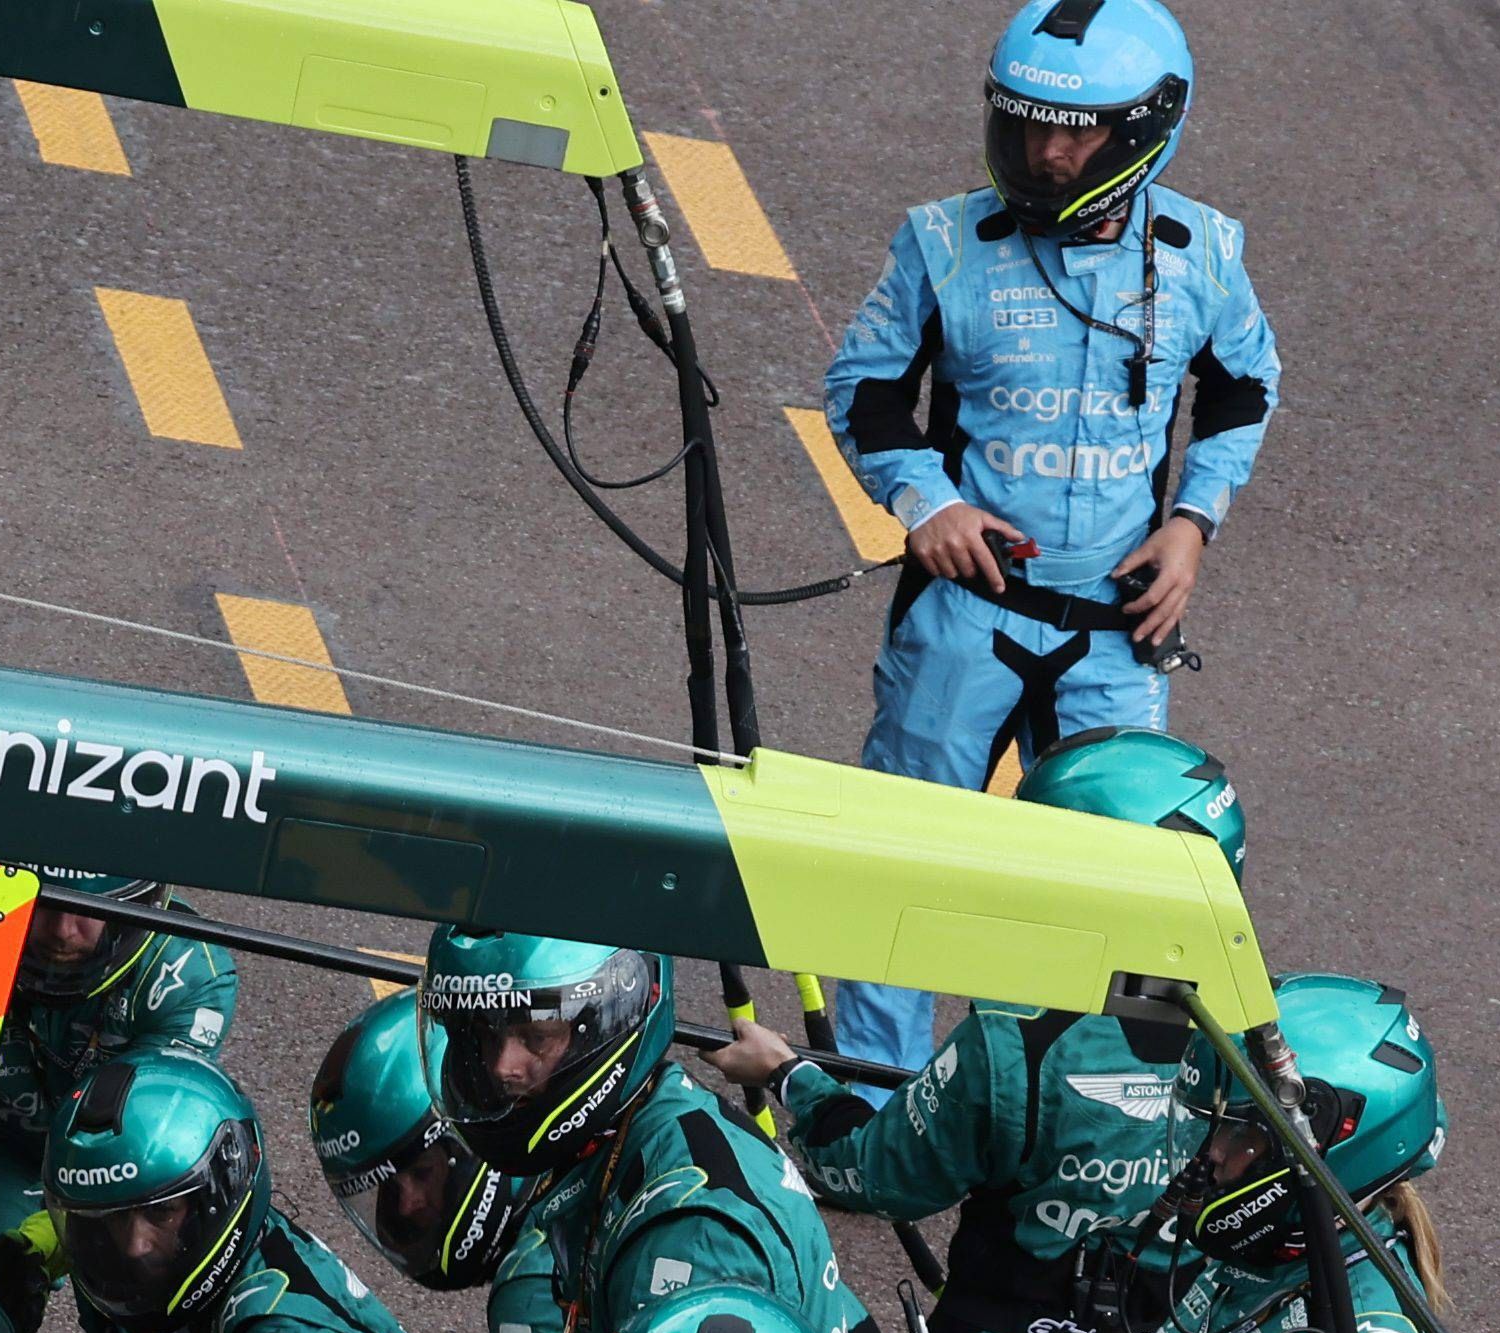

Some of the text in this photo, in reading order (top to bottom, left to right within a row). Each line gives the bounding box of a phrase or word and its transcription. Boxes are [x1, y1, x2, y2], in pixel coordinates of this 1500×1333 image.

[1008, 60, 1083, 90] aramco
[990, 92, 1098, 127] ASTON MARTIN
[1076, 163, 1149, 218] cognizant
[985, 440, 1151, 479] aramco
[431, 971, 514, 992] aramco
[455, 989, 533, 1011] MARTIN
[548, 1061, 627, 1142] cognizant
[1126, 1084, 1163, 1097] ASTON
[57, 1161, 139, 1187] aramco
[455, 1168, 502, 1261] cognizant
[1206, 1181, 1289, 1235] cognizant
[181, 1227, 243, 1310] cognizant
